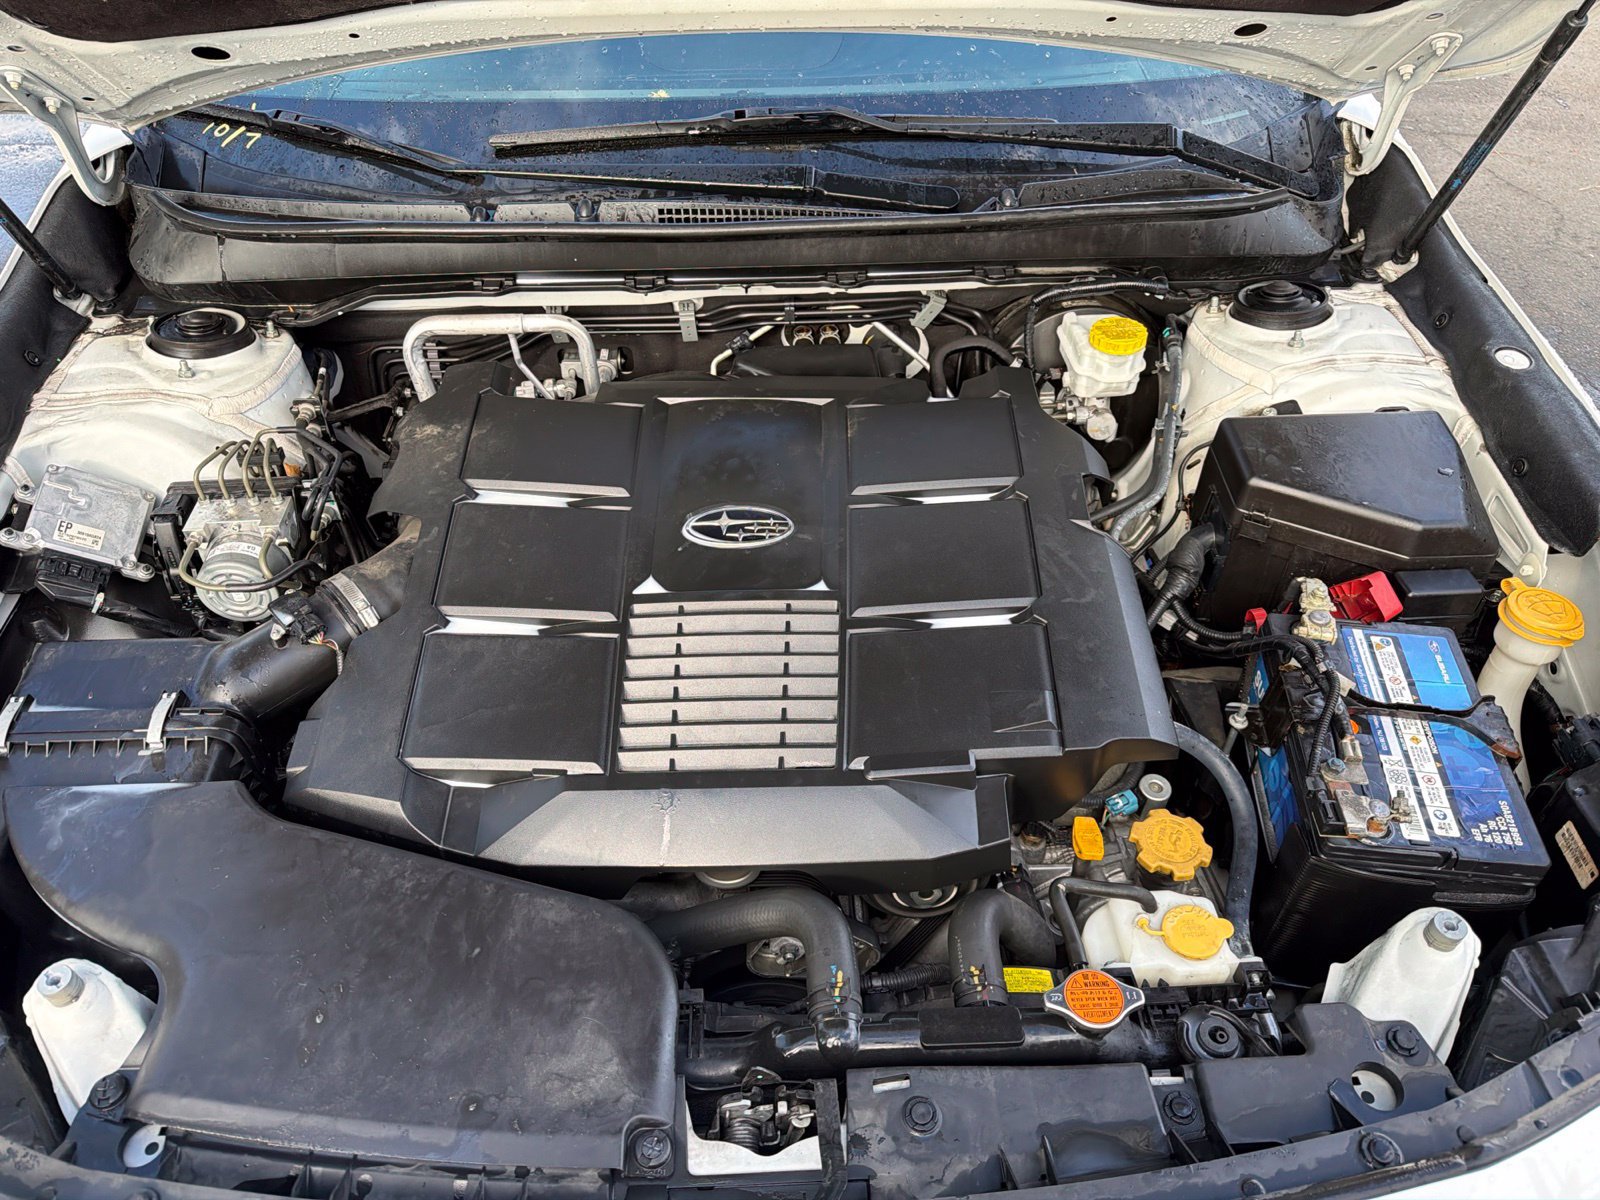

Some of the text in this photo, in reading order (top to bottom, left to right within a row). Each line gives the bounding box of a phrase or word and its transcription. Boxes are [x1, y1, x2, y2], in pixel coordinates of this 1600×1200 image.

[58, 520, 73, 533] EP
[1434, 654, 1451, 684] SUBARU
[1478, 823, 1488, 832] Ah
[1487, 820, 1503, 844] RC 120
[1495, 815, 1513, 845] CCA 750
[1083, 981, 1110, 989] WARNING
